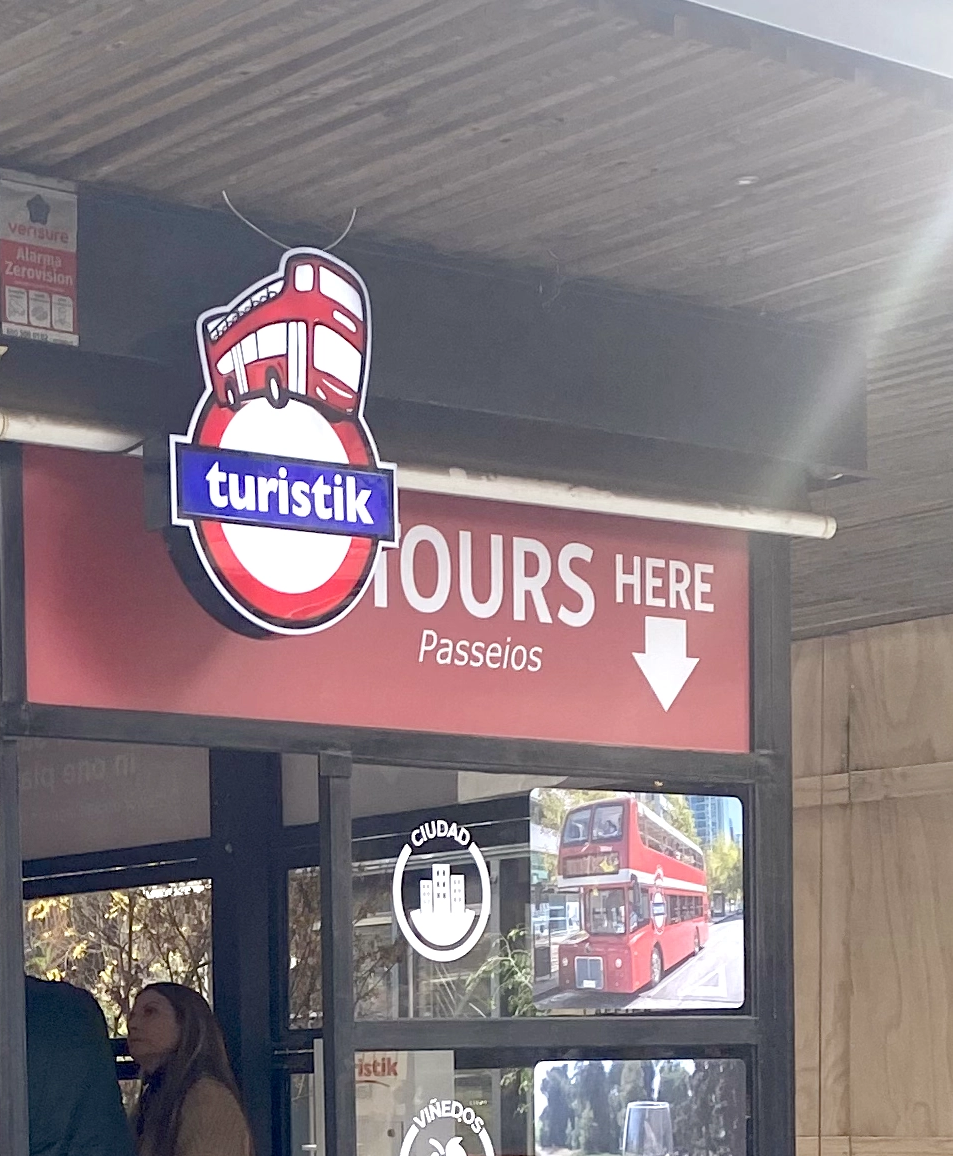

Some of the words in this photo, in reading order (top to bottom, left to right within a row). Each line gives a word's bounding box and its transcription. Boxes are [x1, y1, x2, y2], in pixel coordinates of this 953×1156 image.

[8, 221, 69, 244] verisure
[16, 246, 62, 268] Alarma
[4, 260, 74, 287] Zerovision
[205, 460, 375, 525] turistik
[615, 553, 715, 613] HERE
[417, 629, 543, 672] Passeios
[410, 819, 471, 847] CIUDAD
[355, 1055, 398, 1078] istik
[413, 1098, 485, 1136] VIÑEDOS
